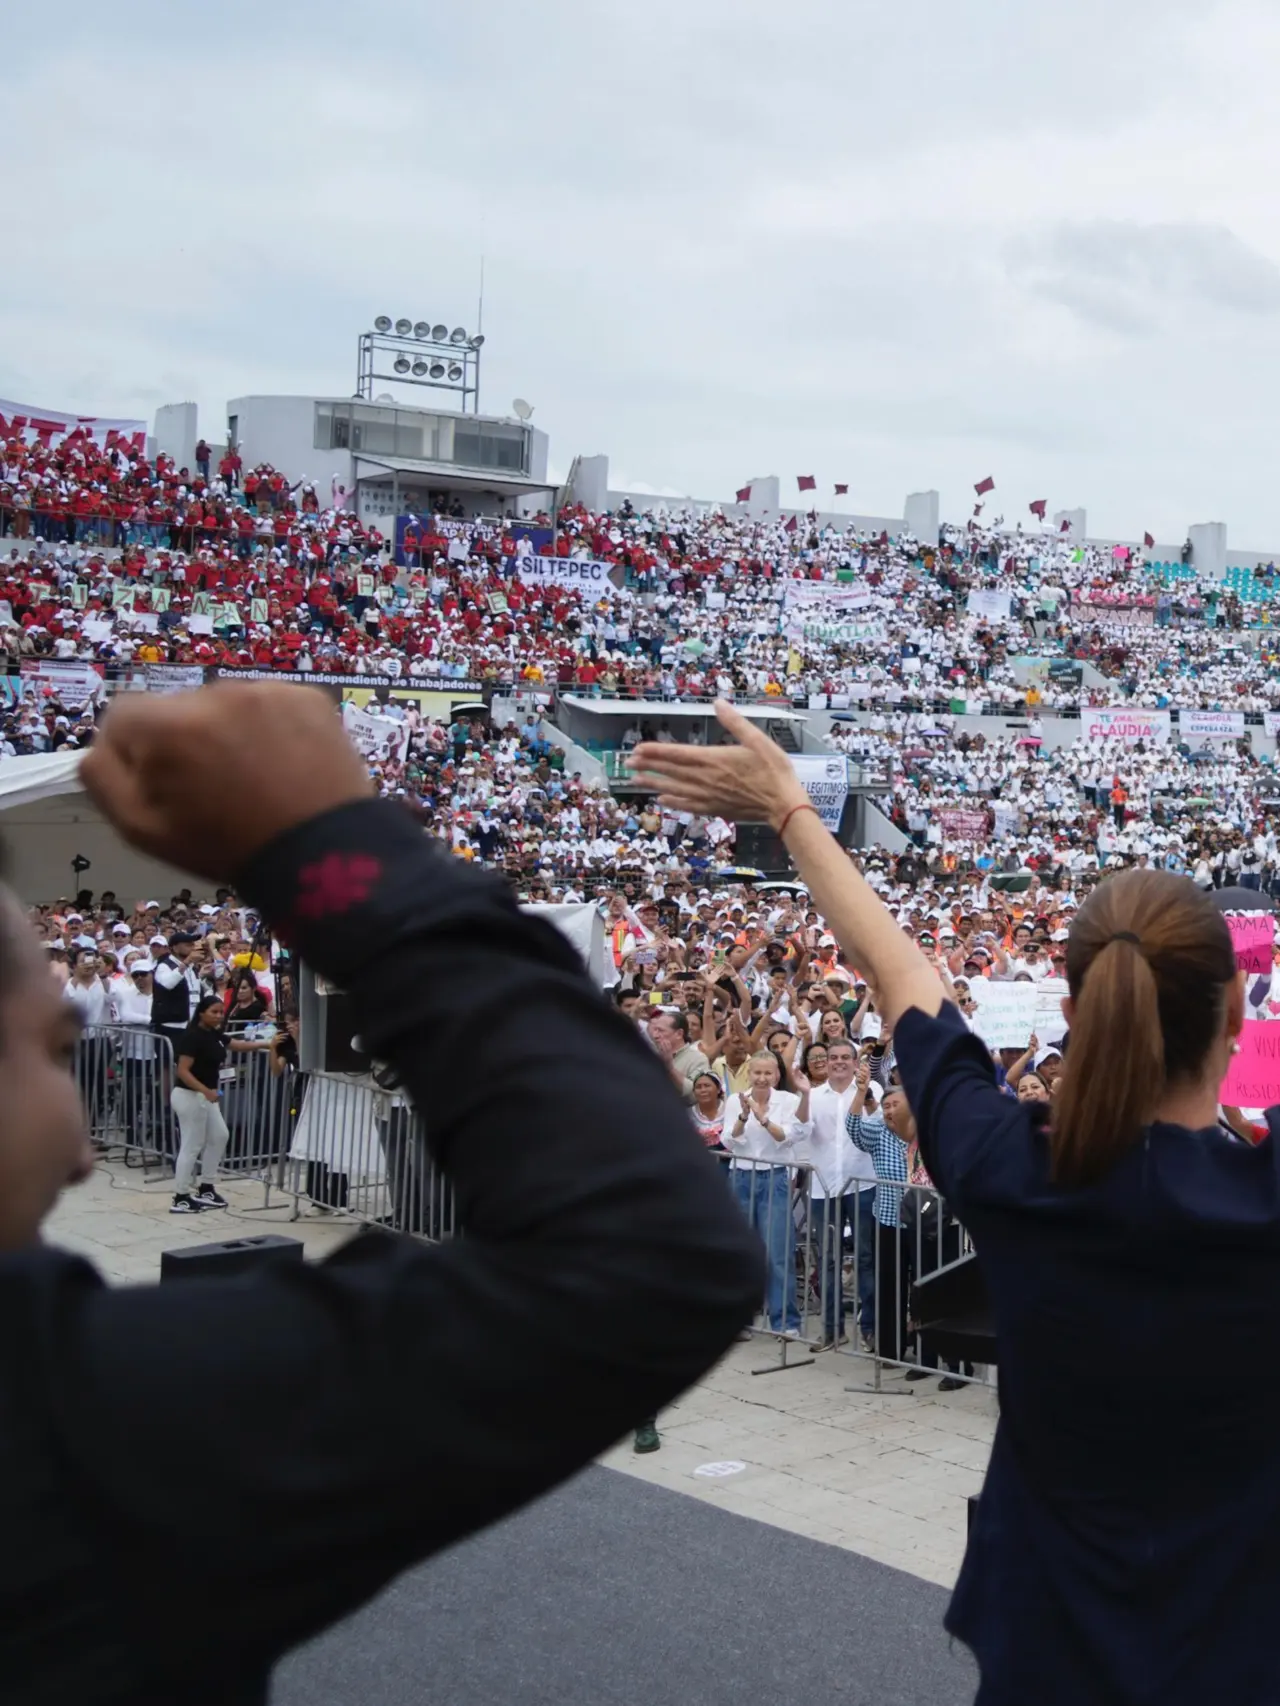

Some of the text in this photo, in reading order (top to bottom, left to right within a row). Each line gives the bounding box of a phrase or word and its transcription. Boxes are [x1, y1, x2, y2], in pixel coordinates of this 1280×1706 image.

[522, 556, 602, 580] SILTEPEC
[218, 667, 302, 682] Coordinadora
[304, 673, 389, 686] Independiente
[410, 677, 483, 690] Trabajadores
[1089, 724, 1151, 736] CLAUDIA
